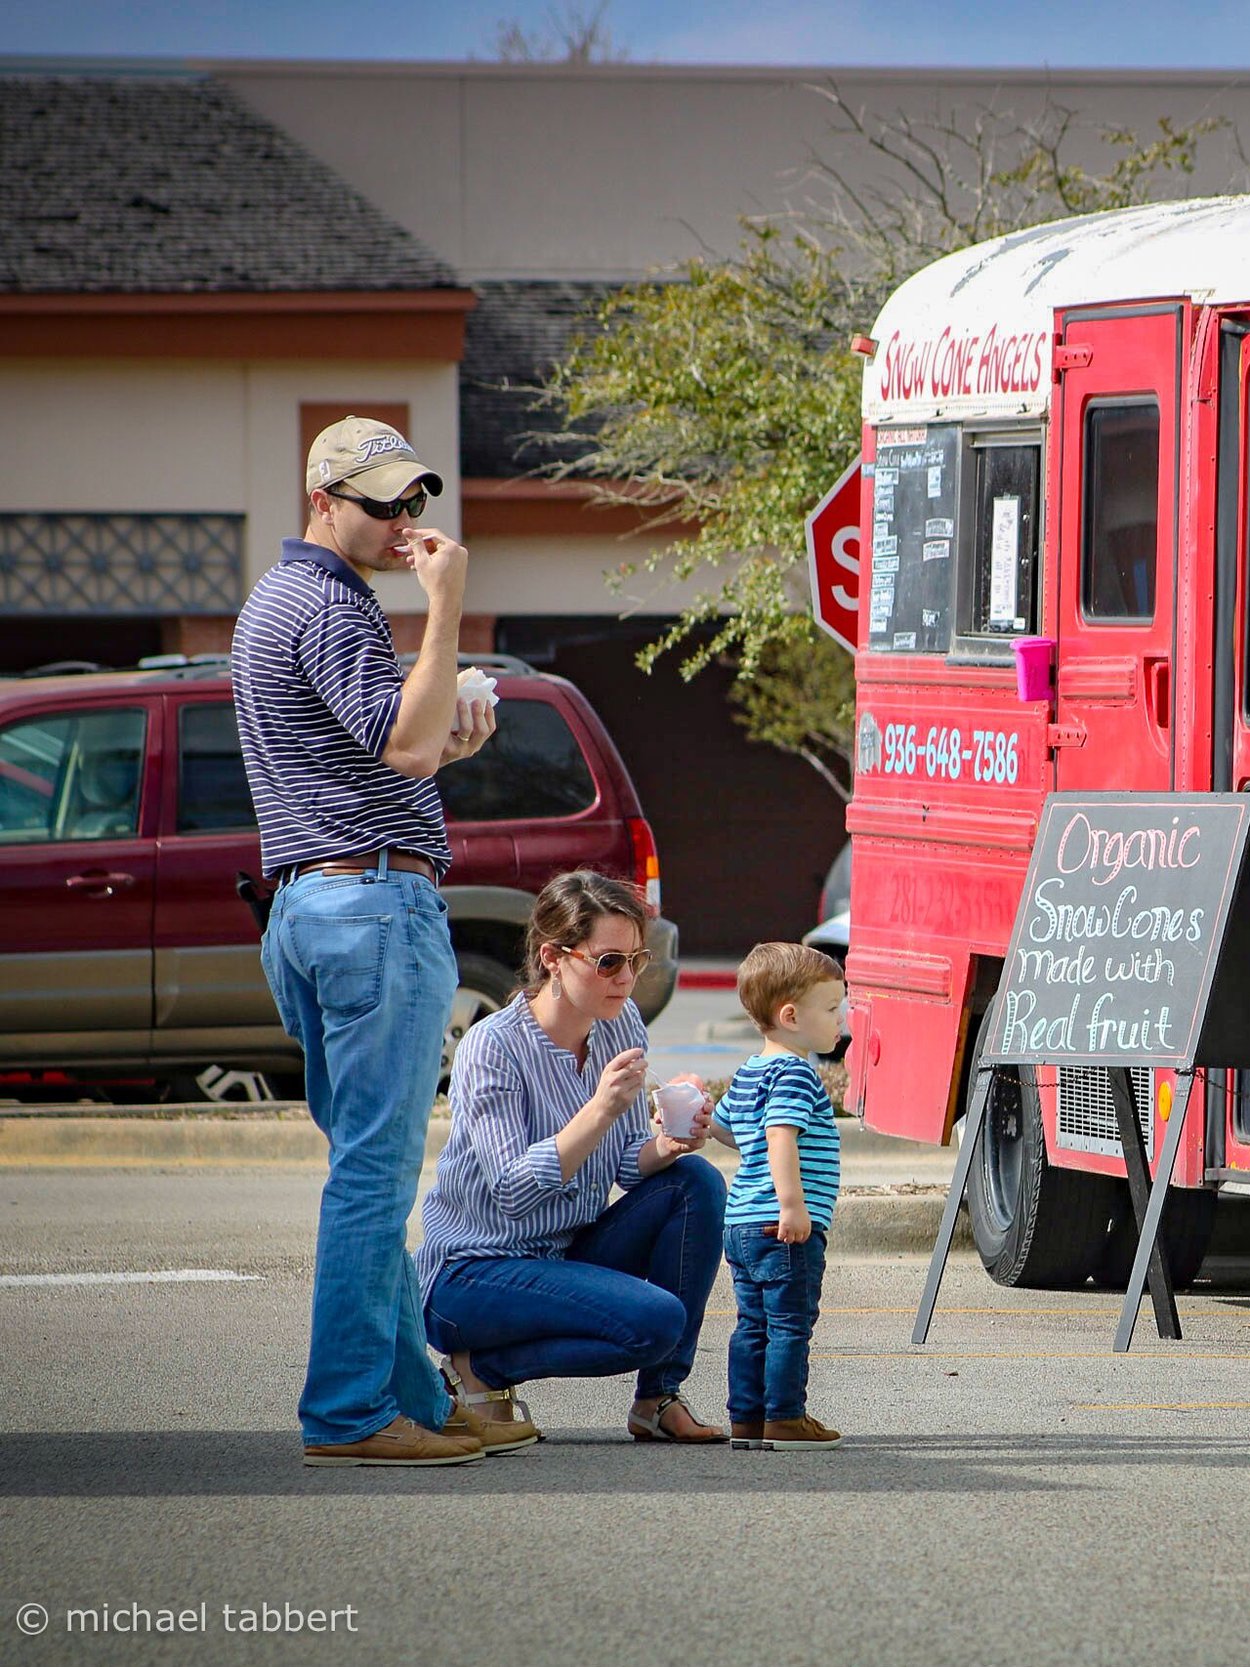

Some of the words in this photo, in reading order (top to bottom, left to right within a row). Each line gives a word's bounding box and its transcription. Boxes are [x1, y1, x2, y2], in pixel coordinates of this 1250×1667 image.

[881, 330, 932, 400] SNOW
[931, 325, 980, 398] CONE
[976, 323, 1047, 394] ANGELS
[884, 723, 1019, 784] 936-648-7586
[1057, 812, 1201, 886] Organic
[1105, 948, 1175, 987] with
[1001, 989, 1081, 1055] Real
[1086, 992, 1176, 1052] fruit
